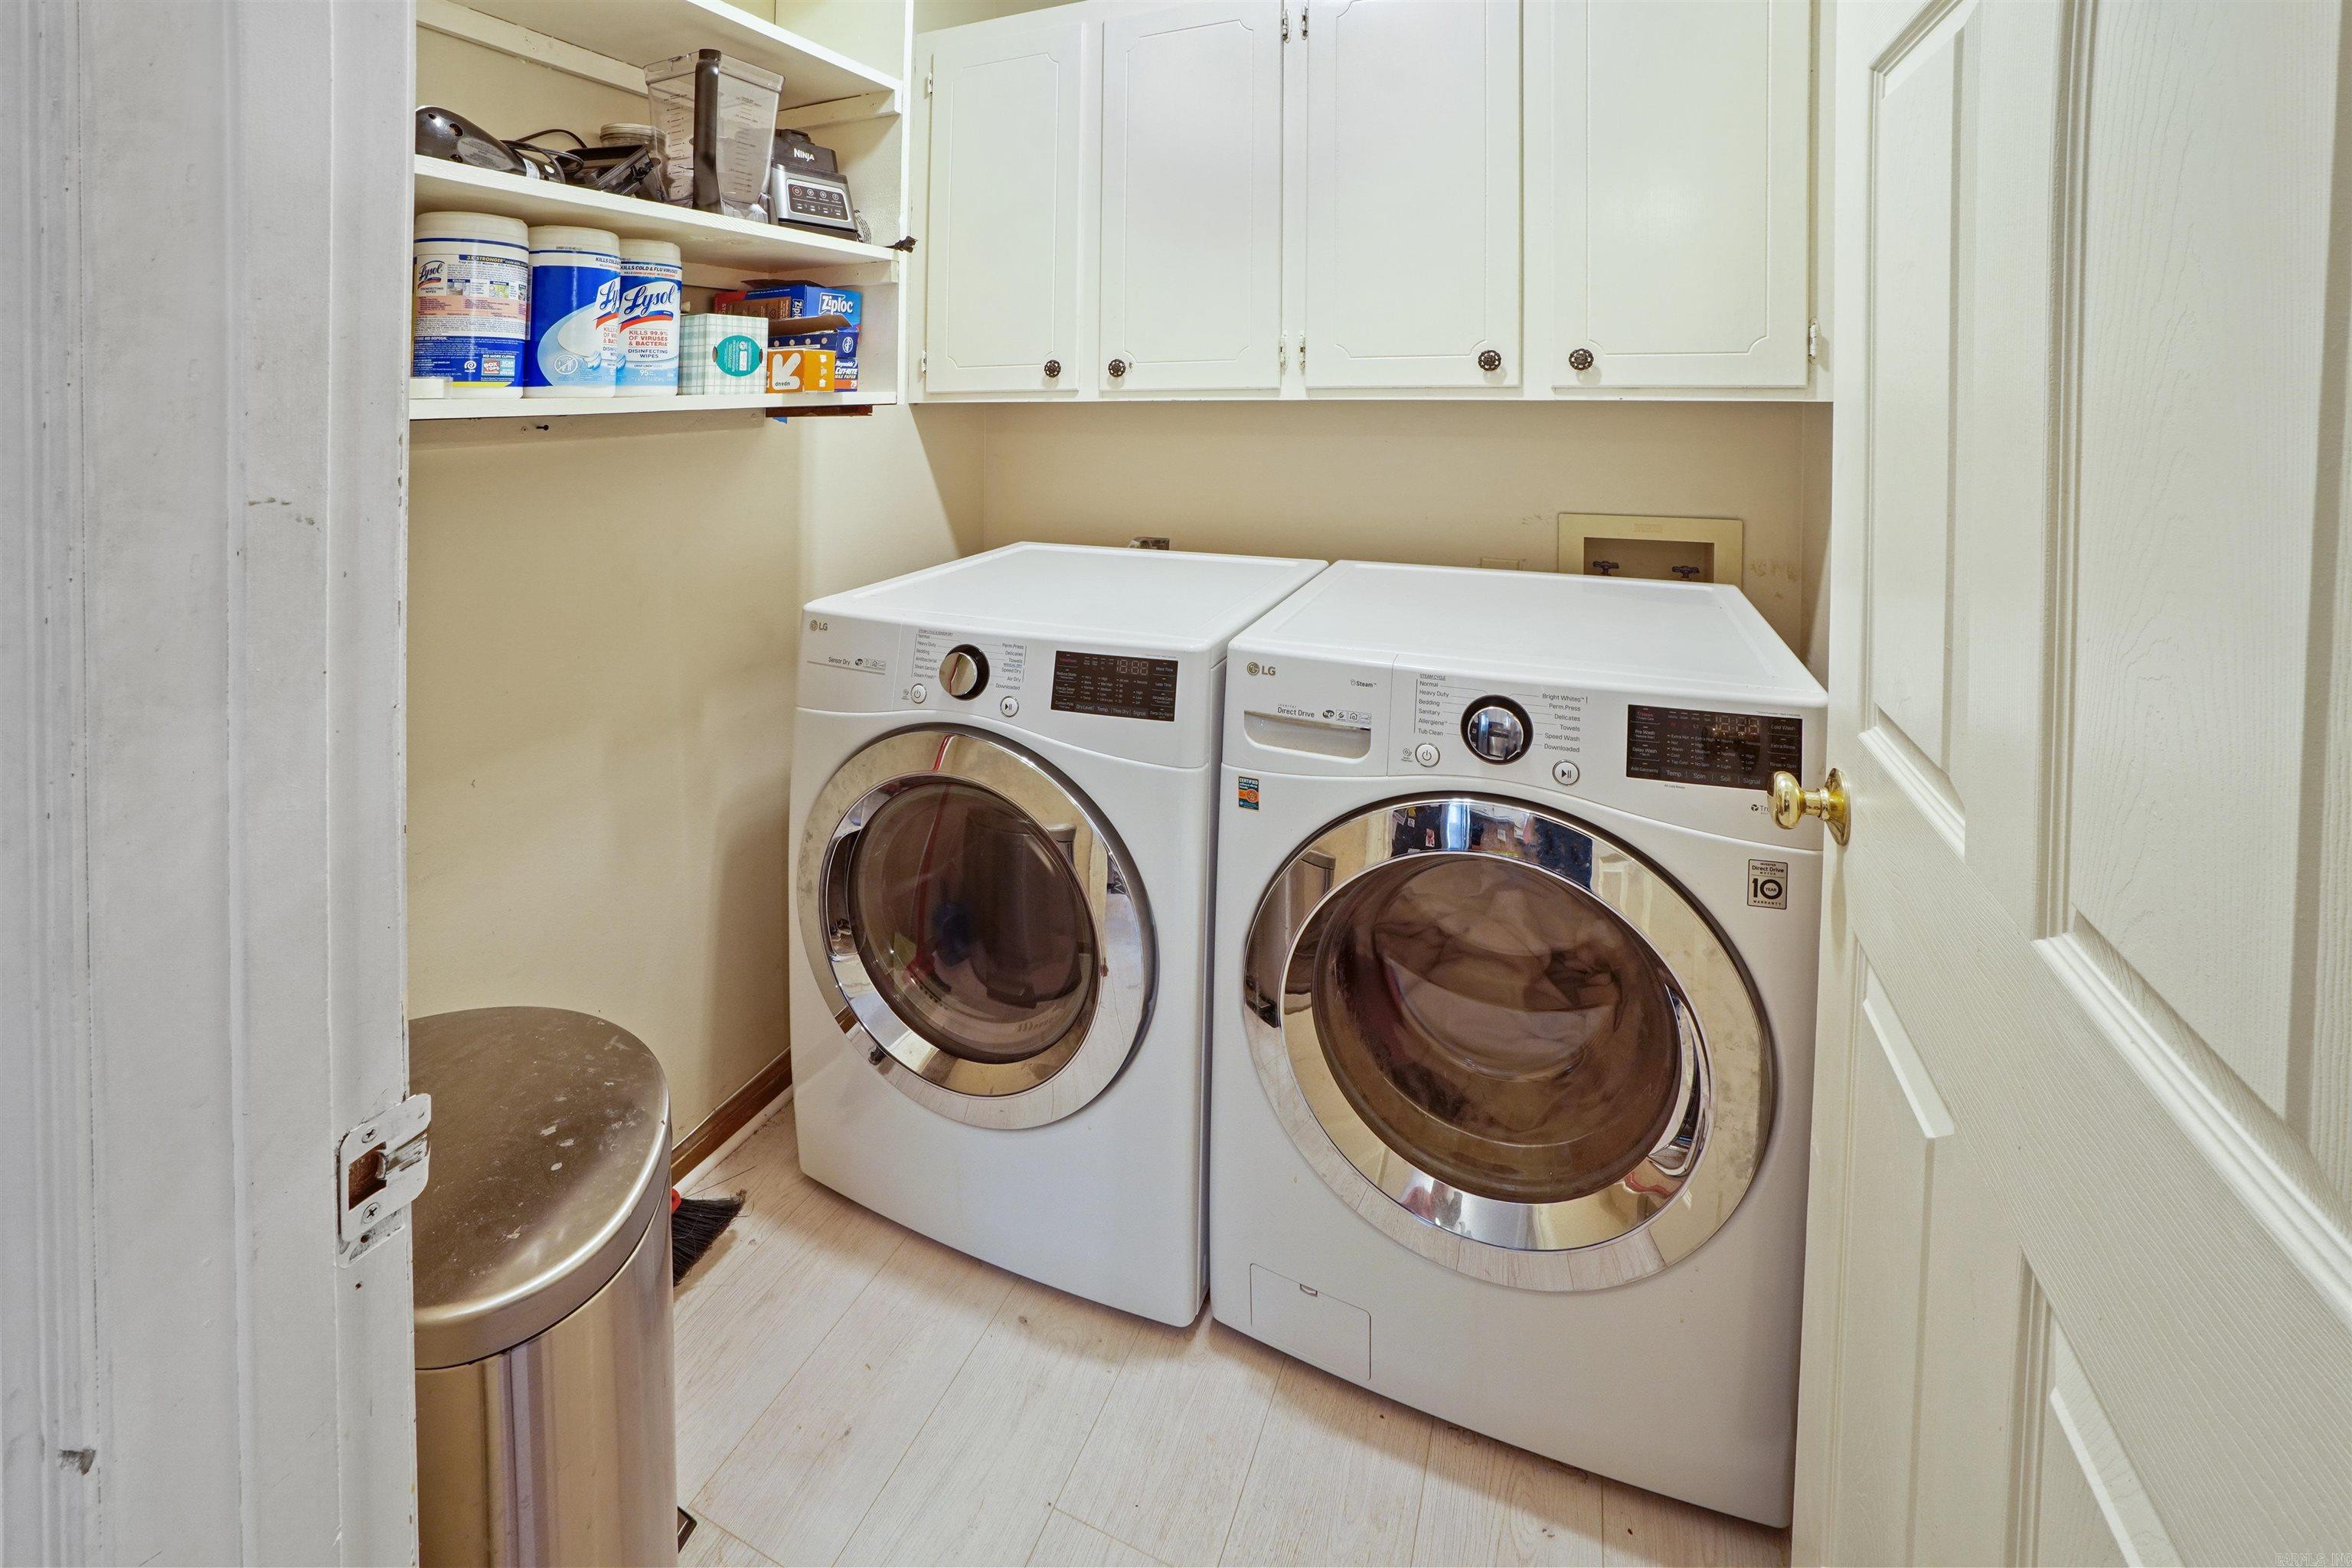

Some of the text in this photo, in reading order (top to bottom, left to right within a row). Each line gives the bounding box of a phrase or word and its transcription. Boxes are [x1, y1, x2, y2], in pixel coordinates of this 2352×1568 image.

[793, 148, 815, 162] NINJA
[418, 263, 443, 281] Lysol
[624, 285, 675, 315] Lysol
[822, 296, 853, 315] Ziploc
[818, 622, 828, 631] LG
[1262, 665, 1276, 676] LG
[1277, 707, 1315, 718] Direct Drive
[1544, 743, 1580, 753] Downloaded
[1752, 877, 1782, 900] 10
